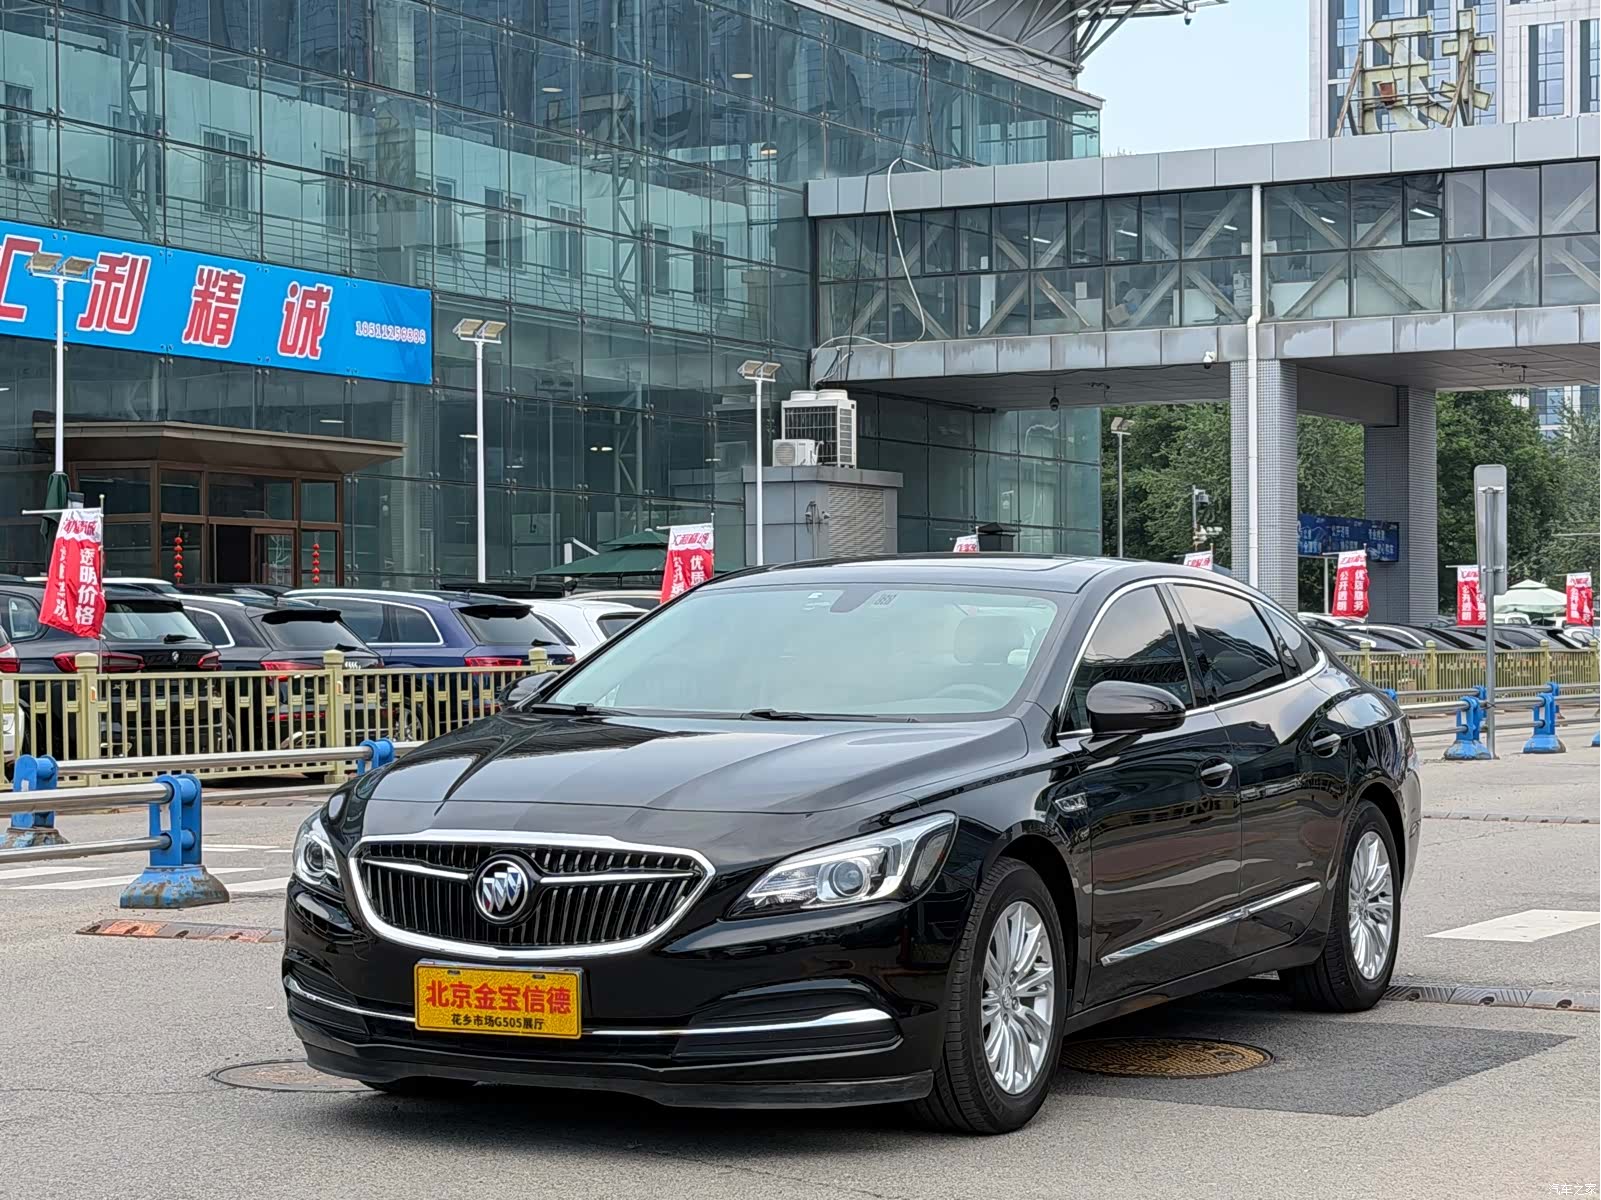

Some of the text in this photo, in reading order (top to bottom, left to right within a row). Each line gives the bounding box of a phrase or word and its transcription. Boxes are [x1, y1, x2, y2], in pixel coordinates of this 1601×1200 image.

[74, 547, 99, 626] 透明价格
[425, 980, 572, 1014] 北京金宝信德
[451, 1013, 545, 1030] 花乡市场G505展厅
